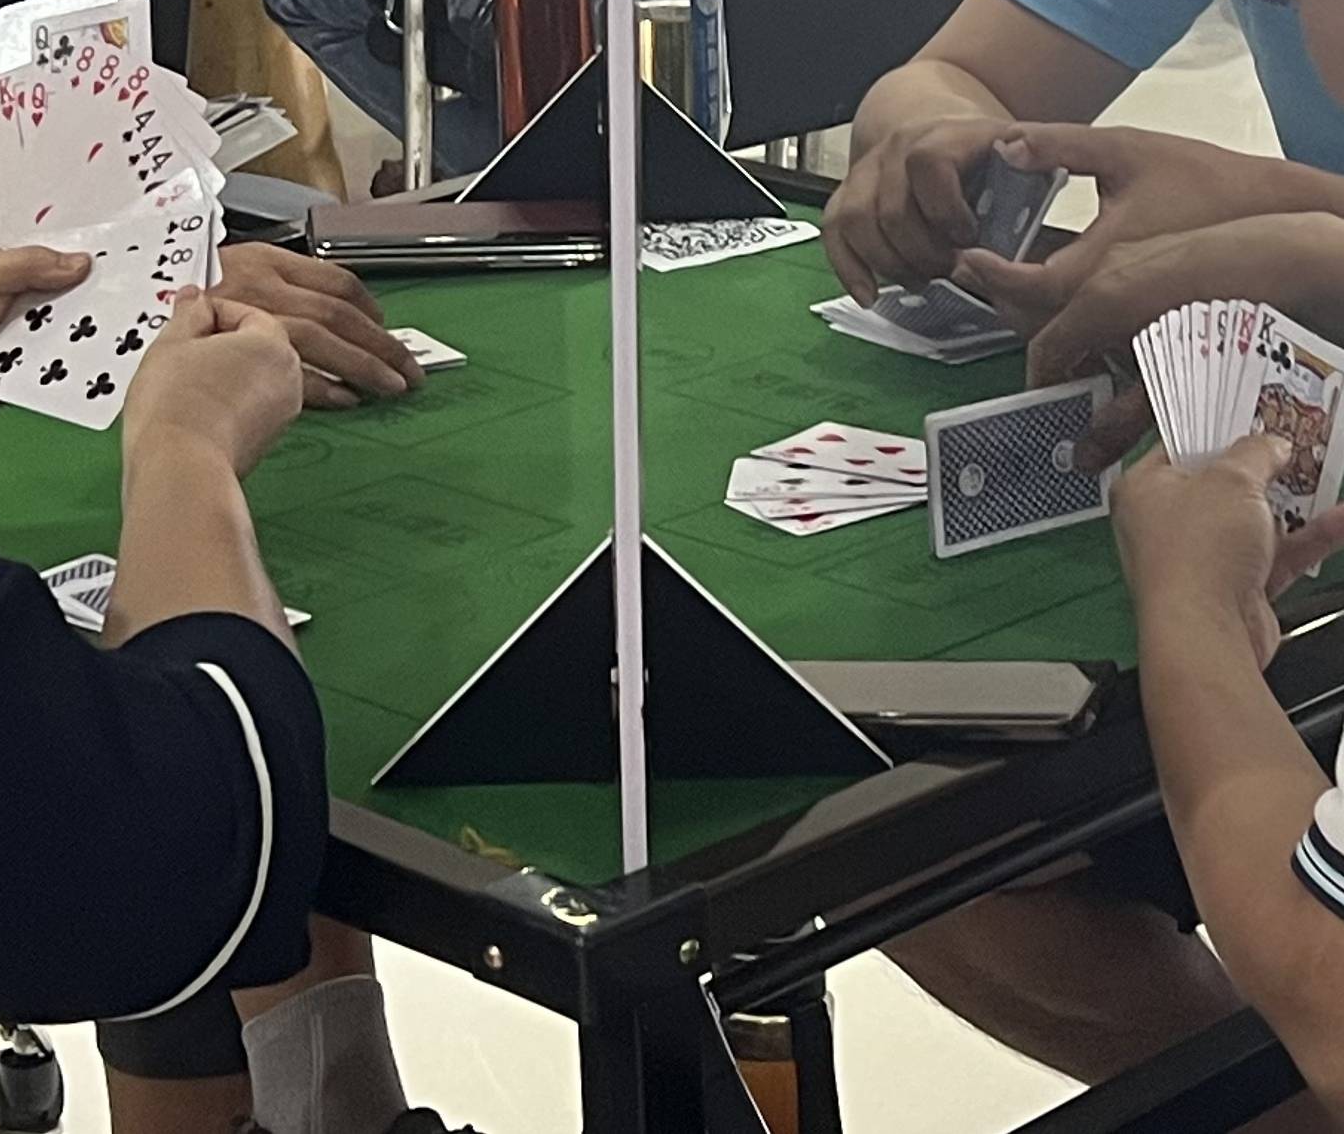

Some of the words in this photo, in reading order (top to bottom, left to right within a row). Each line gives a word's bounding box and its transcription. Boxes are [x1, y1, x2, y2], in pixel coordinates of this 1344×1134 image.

[35, 25, 49, 50] Q
[76, 46, 95, 72] 8
[100, 54, 119, 80] 8
[128, 66, 149, 91] 8
[32, 82, 45, 108] Q
[135, 109, 156, 133] 4
[142, 135, 163, 156] 4
[152, 151, 173, 172] 4
[170, 248, 193, 265] 8
[1258, 312, 1276, 344] K
